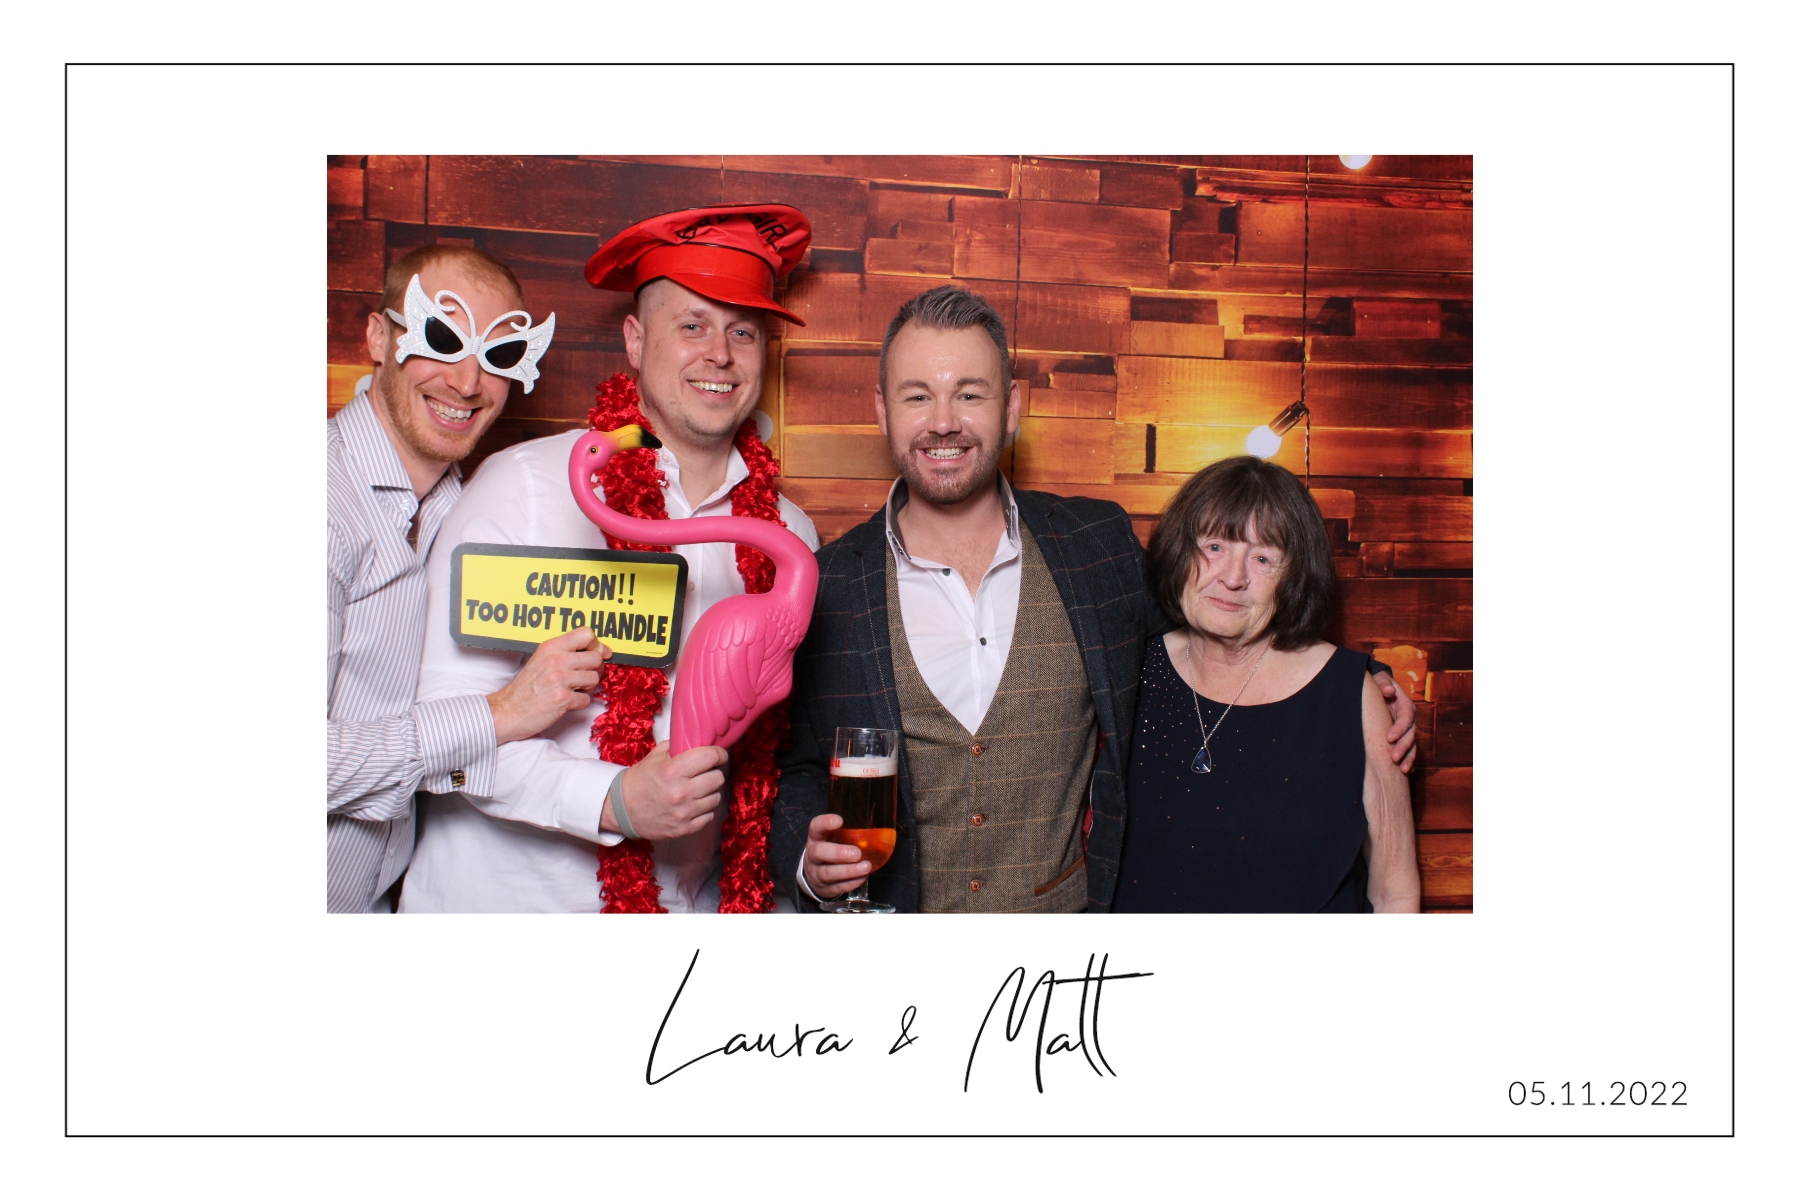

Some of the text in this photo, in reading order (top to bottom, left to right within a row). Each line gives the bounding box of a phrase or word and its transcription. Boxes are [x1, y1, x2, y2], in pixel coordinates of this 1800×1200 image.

[525, 572, 636, 606] CAUTION!!
[466, 599, 669, 646] TOO HOT TO HANDLE
